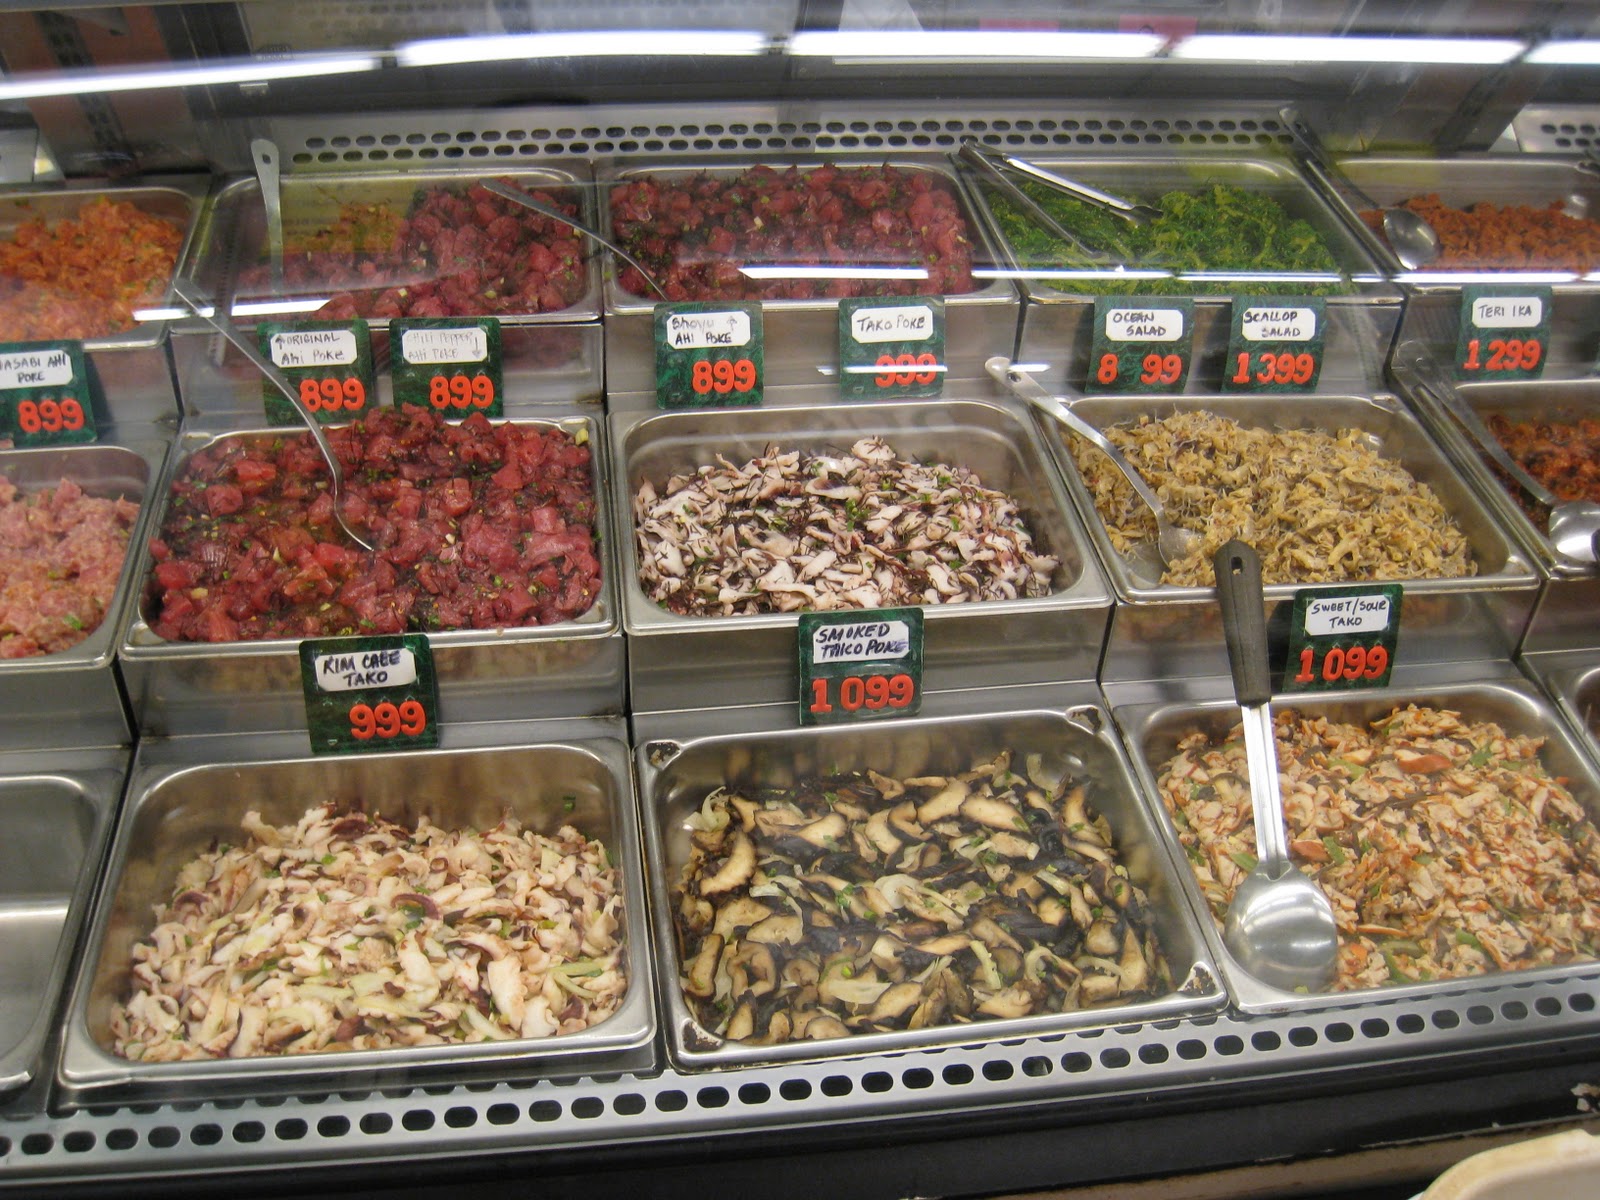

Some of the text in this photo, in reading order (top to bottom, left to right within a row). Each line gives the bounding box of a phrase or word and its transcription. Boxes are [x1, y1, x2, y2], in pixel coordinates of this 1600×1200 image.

[1112, 312, 1154, 323] OCEAN
[1243, 311, 1298, 324] SCALLOP
[1479, 304, 1505, 318] TERI
[857, 315, 926, 332] TAKO POKE
[1126, 325, 1167, 337] SALAD
[286, 333, 341, 346] ORIGINAL
[675, 331, 733, 346] AHI POKE
[47, 353, 66, 368] AHI
[433, 347, 459, 360] POKE
[17, 371, 45, 384] POKE
[692, 359, 756, 394] 899
[875, 354, 937, 388] 999
[300, 378, 365, 412] 899
[429, 375, 495, 409] 899
[17, 398, 84, 433] 899
[1328, 616, 1362, 629] TAKO
[815, 622, 890, 643] SMOKED
[865, 638, 908, 656] POKE
[323, 655, 356, 675] KIM
[342, 670, 388, 688] TAKO
[349, 701, 426, 739] 999
